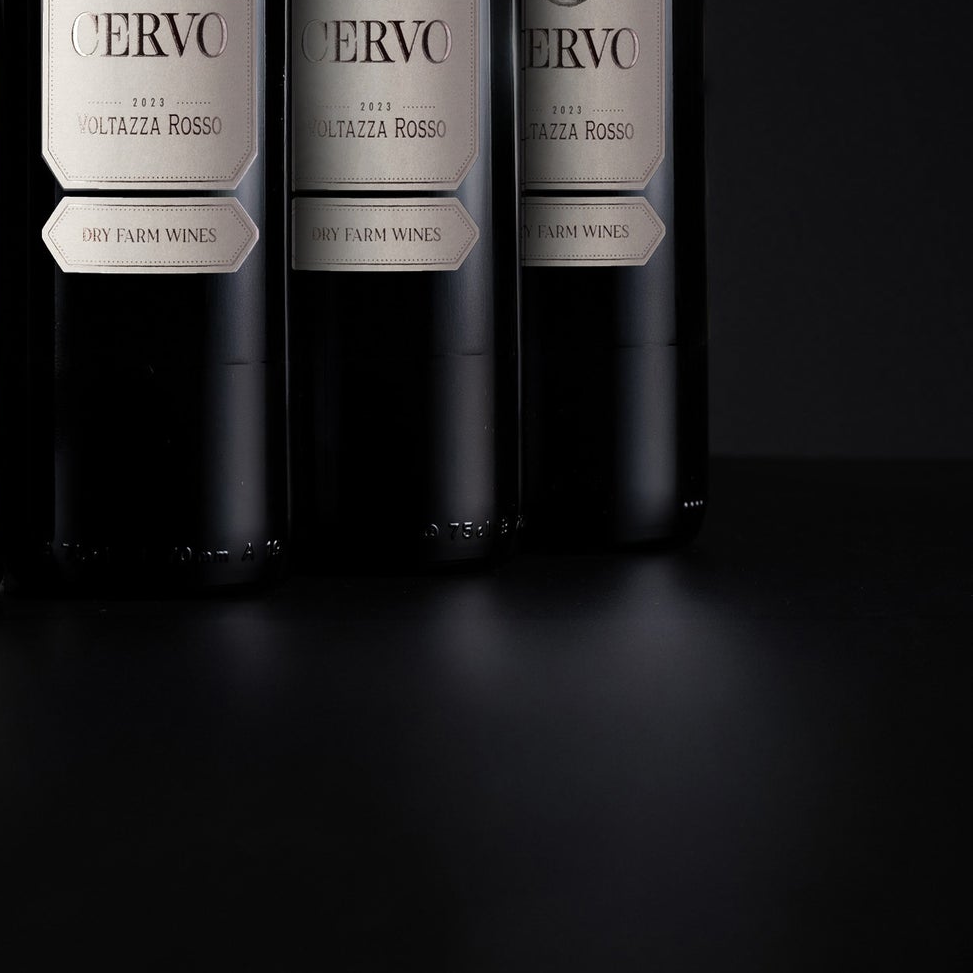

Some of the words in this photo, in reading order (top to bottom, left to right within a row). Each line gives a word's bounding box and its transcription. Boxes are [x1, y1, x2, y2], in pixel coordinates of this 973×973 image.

[71, 11, 228, 59] CERVO
[301, 18, 453, 65] CERVO
[525, 27, 641, 69] ERVO
[132, 97, 165, 108] 2023
[360, 101, 392, 112] 2023
[552, 105, 583, 115] 2023
[168, 113, 222, 136] ROSSO
[394, 117, 447, 139] ROSSO
[524, 122, 579, 141] TAZZA
[584, 120, 635, 141] ROSSO
[82, 228, 111, 243] DRY
[116, 228, 160, 243] FARM
[166, 227, 217, 243] WINES
[312, 228, 340, 242] DRY
[345, 228, 387, 242] FARM
[392, 227, 442, 242] WINES
[538, 225, 578, 239] FARM
[583, 224, 630, 239] WINES
